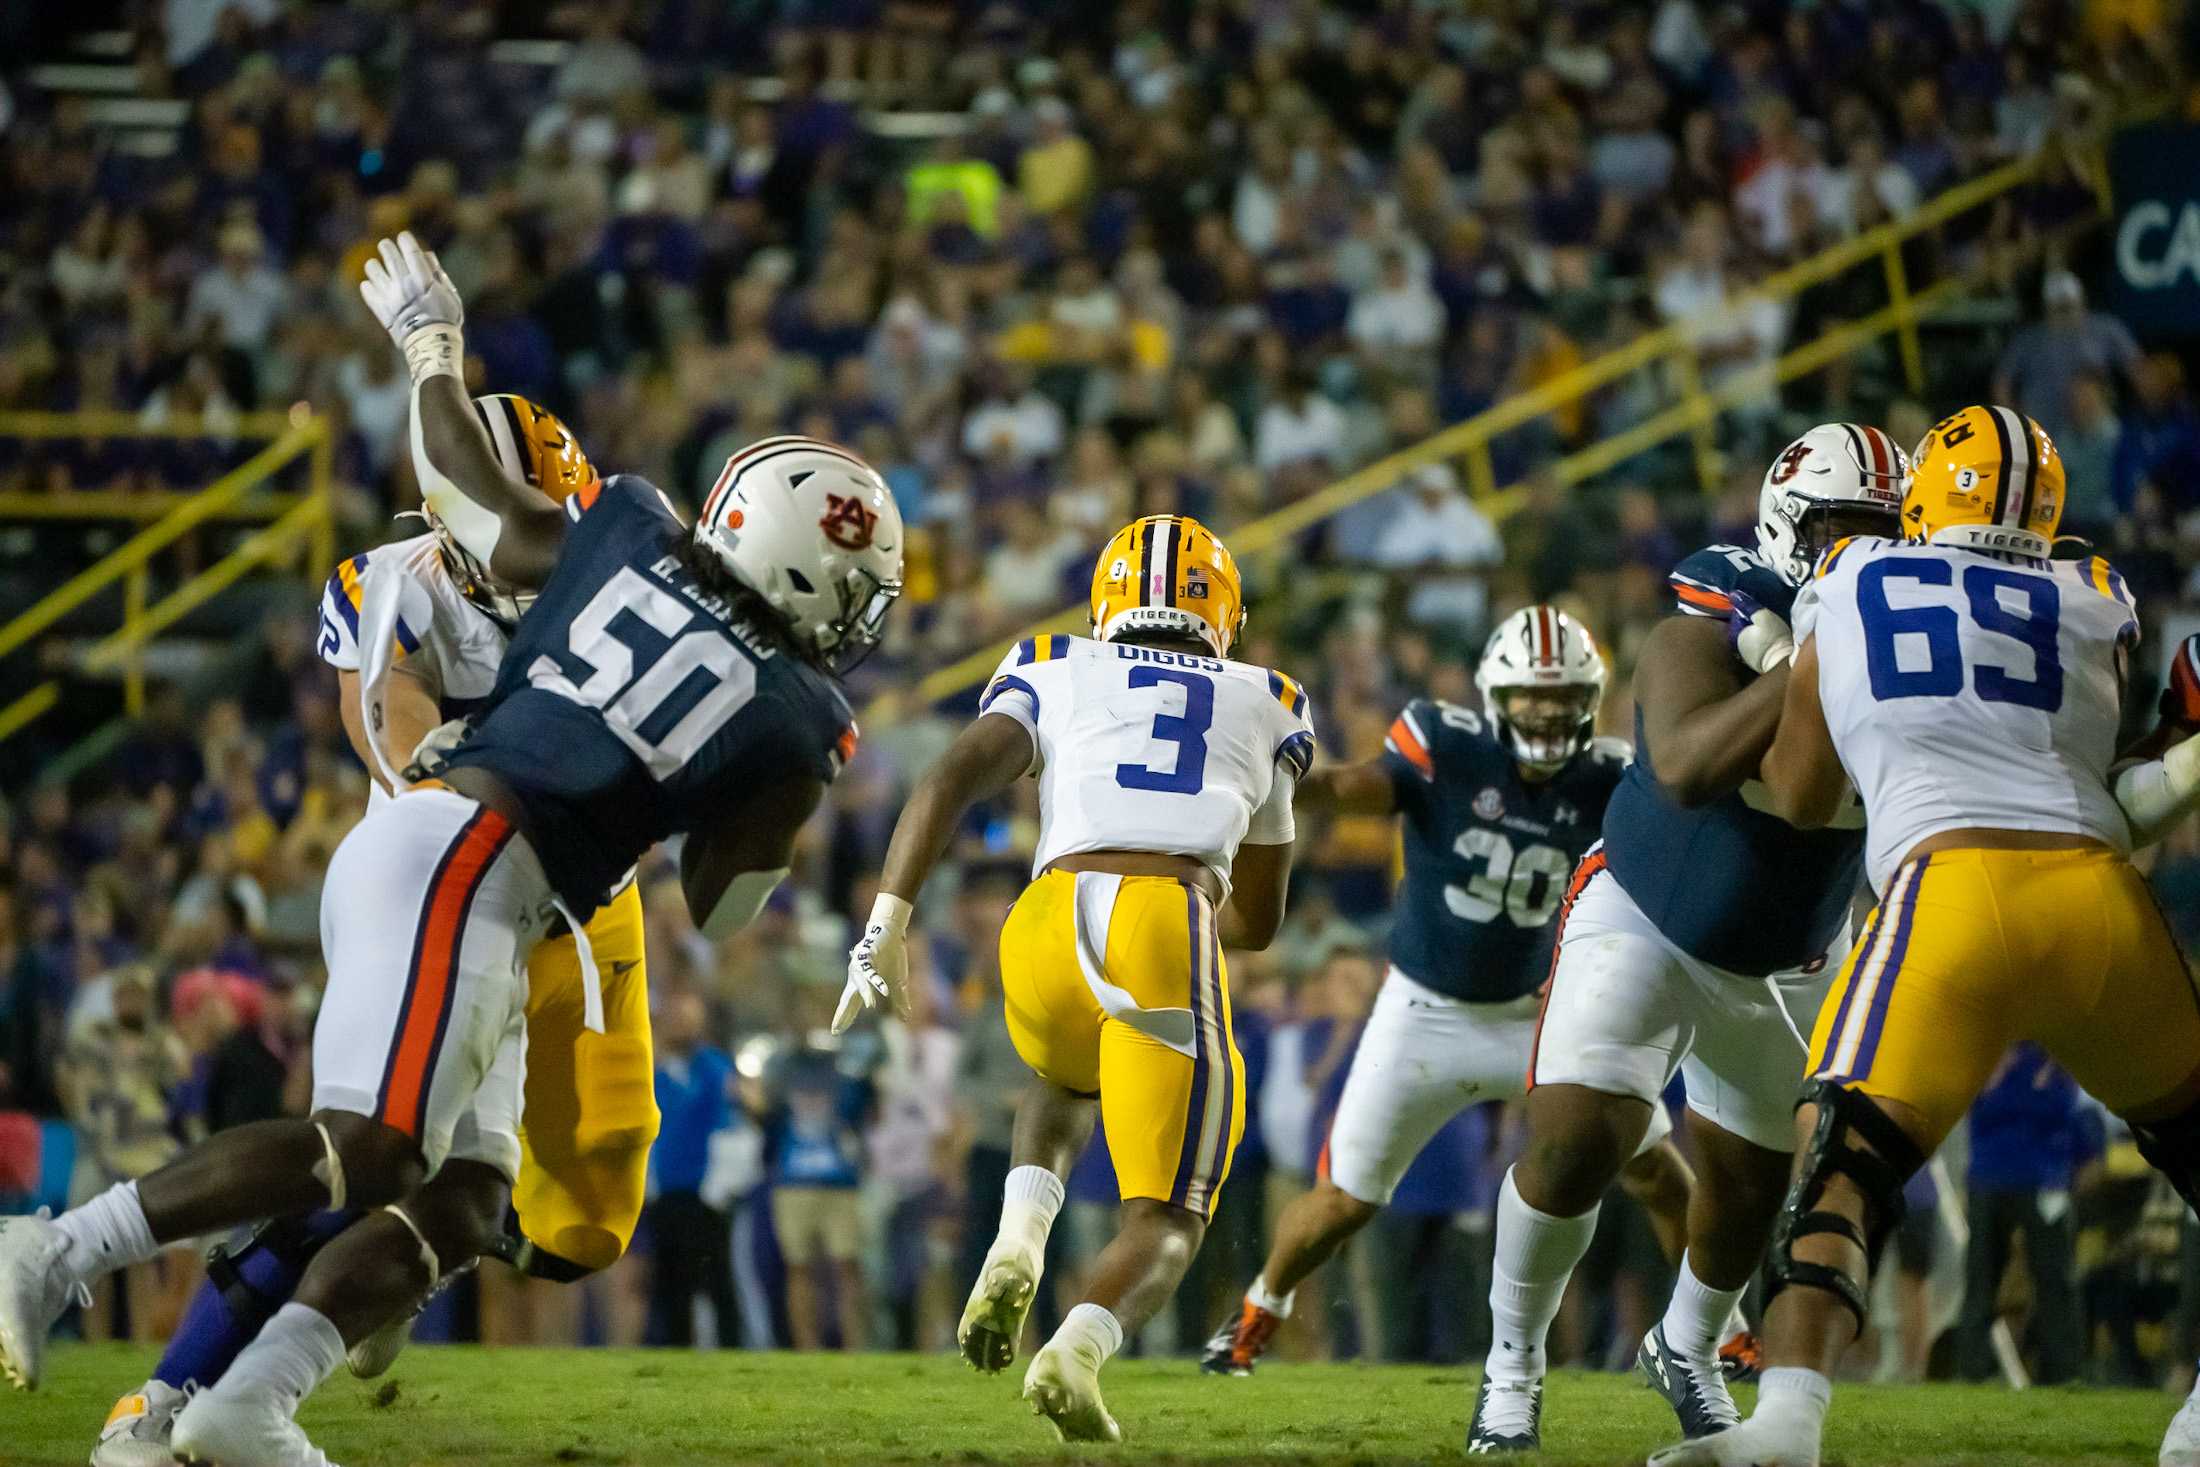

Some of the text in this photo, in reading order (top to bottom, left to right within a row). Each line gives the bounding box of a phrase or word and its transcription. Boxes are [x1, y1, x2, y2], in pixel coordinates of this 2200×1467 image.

[1962, 472, 1972, 487] 3
[1968, 531, 2044, 552] TIGERS
[1131, 610, 1190, 622] TIGERS
[1179, 587, 1186, 598] 3
[1856, 556, 2065, 714] 69
[527, 565, 757, 782] 50
[1115, 664, 1215, 796] 3
[1444, 826, 1570, 928] 30
